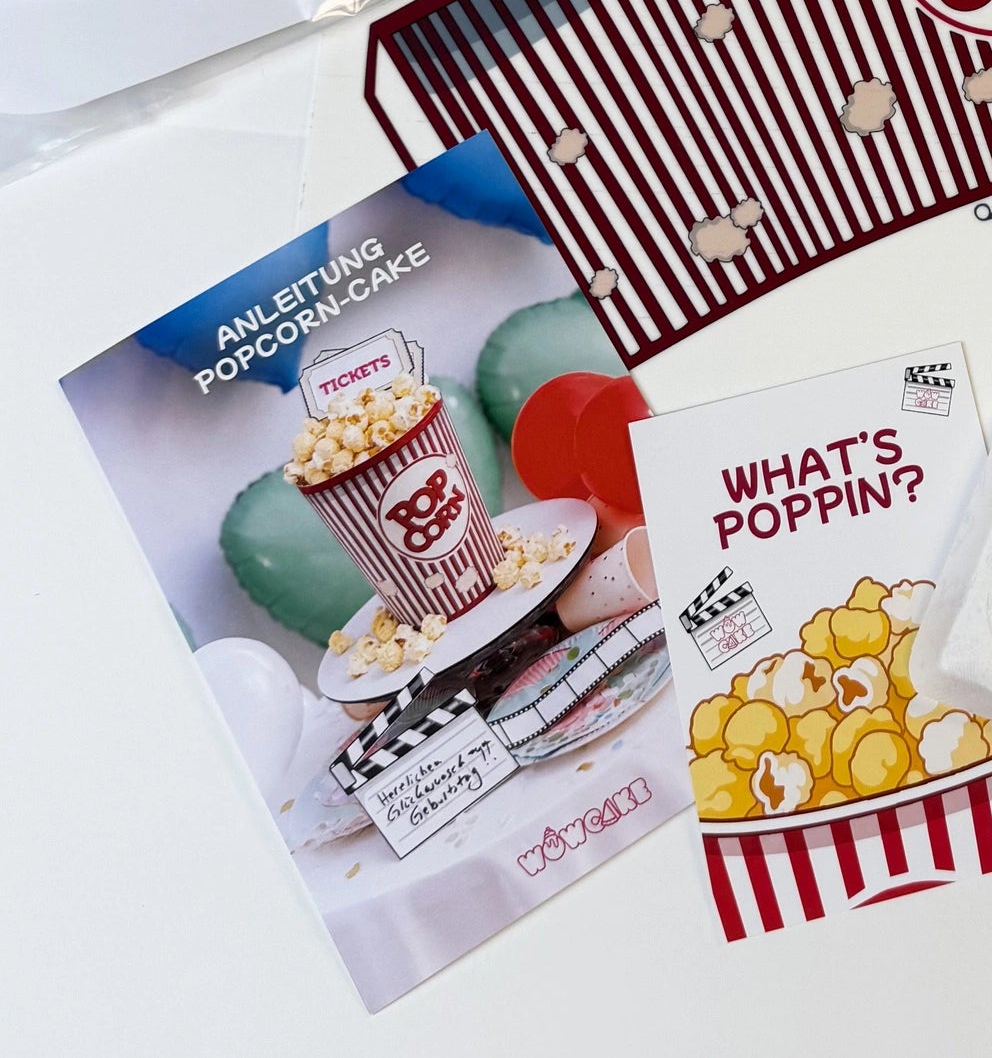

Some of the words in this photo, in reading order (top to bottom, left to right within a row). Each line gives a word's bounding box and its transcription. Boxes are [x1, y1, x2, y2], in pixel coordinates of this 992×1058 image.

[193, 242, 431, 394] POPCORN-CAKE
[217, 238, 386, 351] ANLEITUNG
[318, 354, 391, 396] TICKETS
[385, 468, 448, 526] POP
[721, 428, 903, 503] WHAT'S
[404, 484, 466, 553] CORN
[713, 465, 924, 550] POPPIN?
